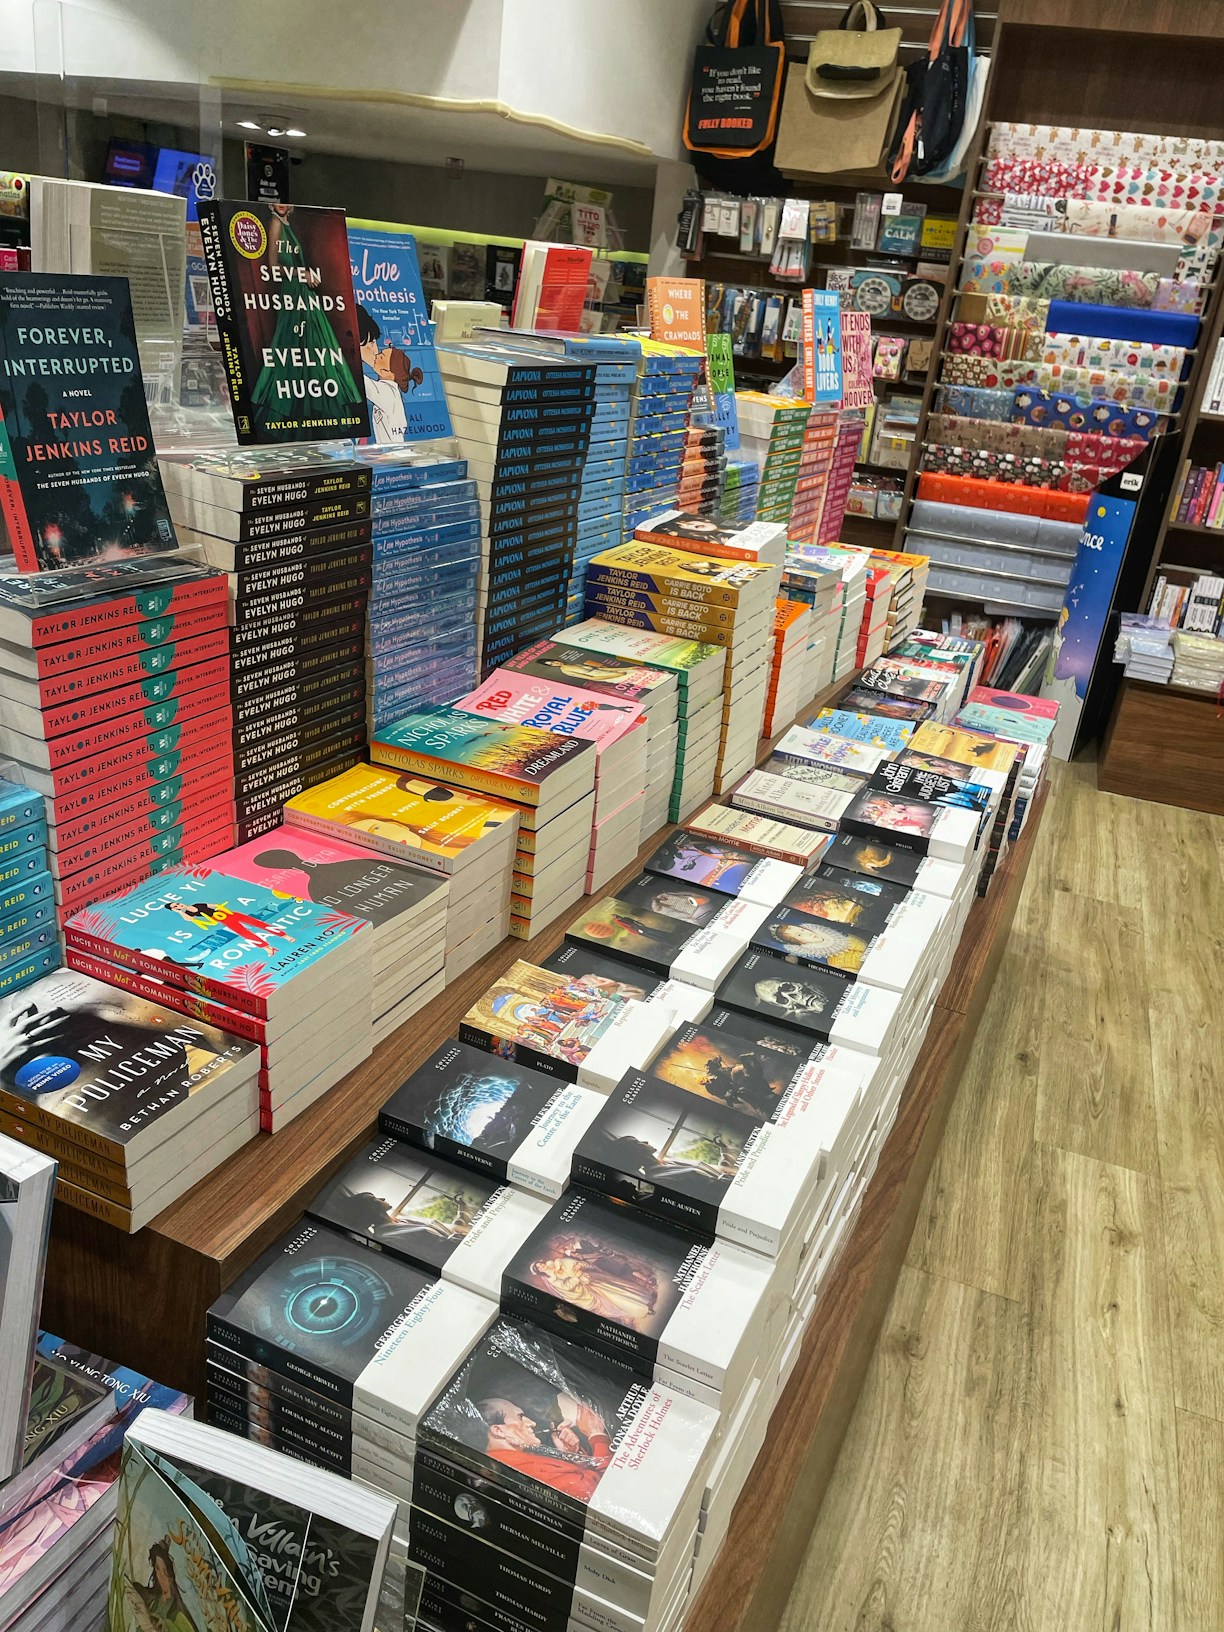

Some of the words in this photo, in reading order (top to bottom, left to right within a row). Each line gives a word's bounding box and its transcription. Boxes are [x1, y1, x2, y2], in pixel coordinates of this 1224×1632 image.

[748, 67, 762, 75] like
[740, 83, 762, 92] found
[703, 95, 714, 103] the
[715, 94, 732, 103] right
[699, 120, 720, 129] FULLY
[721, 118, 753, 129] BOOKED
[237, 221, 257, 231] Daisy
[885, 228, 916, 241] CALM
[244, 244, 258, 252] Six
[276, 240, 300, 255] The
[200, 217, 217, 272] EVELYN
[211, 275, 225, 317] HUGO
[259, 265, 322, 283] SEVEN
[362, 249, 400, 285] Love
[243, 293, 347, 312] HUSBANDS
[668, 290, 692, 299] WHERE
[675, 311, 689, 320] THE
[841, 313, 849, 331] IT
[850, 313, 870, 331] ENDS
[17, 328, 112, 348] FOREVER,
[293, 321, 307, 337] of
[664, 331, 700, 341] CRAWDADS
[842, 335, 861, 357] WITH
[4, 357, 134, 376] INTERRUPTED
[223, 332, 234, 371] JENKINS
[230, 372, 240, 402] REID
[231, 347, 243, 385] TAYLOR
[261, 348, 345, 368] EVELYN
[844, 356, 853, 373] US
[511, 370, 541, 381] LAPVONA
[276, 379, 340, 400] HUGO
[844, 391, 874, 408] HOOVER
[47, 410, 118, 429] TAYLOR
[265, 421, 299, 431] TAYLOR
[302, 419, 338, 428] JENKINS
[341, 417, 361, 426] REID
[409, 413, 423, 423] ALI
[391, 425, 446, 436] HAZELWOOD
[26, 440, 103, 462] JENKINS
[108, 436, 148, 454] REID
[50, 481, 70, 489] SEVEN
[71, 477, 102, 486] HUSBANDS
[112, 473, 131, 481] EVELYN
[133, 471, 150, 479] HUGO
[314, 485, 338, 494] JENKINS
[323, 477, 343, 485] TAYLOR
[1123, 477, 1139, 488] erik
[252, 493, 282, 506] EVELYN
[284, 490, 307, 501] HUGO
[596, 573, 627, 588] JENKINS
[628, 580, 648, 591] REID
[609, 567, 639, 581] TAYLOR
[664, 579, 692, 592] CARRIE
[694, 583, 712, 595] SOTO
[670, 587, 680, 596] IS
[680, 589, 705, 601] BACK
[476, 690, 513, 714] RED
[495, 693, 543, 723] WHITE
[520, 695, 572, 729] ROYAL
[396, 710, 469, 747] NICHOLAS
[550, 707, 595, 736] BLUE
[424, 718, 489, 750] SPARKS
[524, 739, 579, 776] DREAMLAND
[785, 755, 807, 765] LITTLE
[811, 761, 845, 774] WOMEN
[880, 762, 900, 777] John
[886, 766, 911, 793] Grisham
[912, 771, 928, 784] THE
[934, 776, 952, 792] LIST
[343, 797, 362, 812] WITH
[398, 800, 420, 814] NOVEL
[417, 821, 439, 836] SALLY
[439, 805, 465, 823] ROONEY
[321, 894, 342, 908] NO
[337, 865, 395, 900] LONGER
[354, 879, 415, 913] HUMAN
[119, 892, 184, 924] LUCIE
[180, 880, 207, 892] YI
[166, 929, 193, 945] IS
[190, 901, 234, 931] Not
[236, 896, 257, 907] A
[209, 905, 314, 970] ROMANTIC
[269, 939, 317, 973] LAUREN
[317, 929, 336, 942] HO
[78, 1034, 124, 1062] MY
[61, 1025, 204, 1113] POLICEMAN
[536, 1061, 554, 1071] PLATO
[32, 1073, 51, 1091] PRIME
[51, 1063, 72, 1080] VIDEO
[119, 1089, 180, 1131] BETHAN
[181, 1045, 243, 1088] ROBERTS
[537, 1125, 556, 1148] Centre
[554, 1118, 563, 1127] of
[562, 1108, 571, 1119] the
[568, 1093, 583, 1111] Earth
[539, 1102, 560, 1131] Journey
[558, 1098, 565, 1106] to
[563, 1091, 574, 1102] the
[457, 1149, 474, 1160] JULES
[474, 1156, 493, 1168] VERNE
[660, 1196, 677, 1207] JANE
[677, 1202, 701, 1216] AUSTEN
[463, 1228, 483, 1247] Pride
[481, 1217, 492, 1230] and
[490, 1190, 515, 1222] Prejudice
[680, 1295, 693, 1311] The
[692, 1270, 710, 1296] Scarlet
[707, 1250, 721, 1272] Letter
[373, 1308, 409, 1351] GEORGE
[403, 1282, 436, 1314] ORWELL
[373, 1328, 409, 1366] Nineteen
[406, 1286, 446, 1331] Eighty-Four
[286, 1361, 311, 1377] GEORGE
[313, 1376, 339, 1391] ORWELL
[100, 1373, 131, 1395] TONG
[128, 1388, 151, 1404] XIU
[614, 1383, 642, 1421] ARTHUR
[46, 1405, 68, 1424] XIU
[608, 1417, 632, 1452] CONAN
[627, 1385, 652, 1422] DOYLE
[611, 1450, 625, 1471] The
[624, 1404, 656, 1457] Adventures
[651, 1390, 662, 1404] of
[628, 1431, 655, 1471] Sherlock
[649, 1397, 673, 1433] Holmes
[508, 1497, 527, 1511] WALT
[528, 1507, 563, 1529] WHITMAN
[499, 1523, 533, 1542] HERMAN
[533, 1537, 566, 1560] MELVILLE
[583, 1563, 601, 1578] Moby
[602, 1571, 616, 1585] Dick
